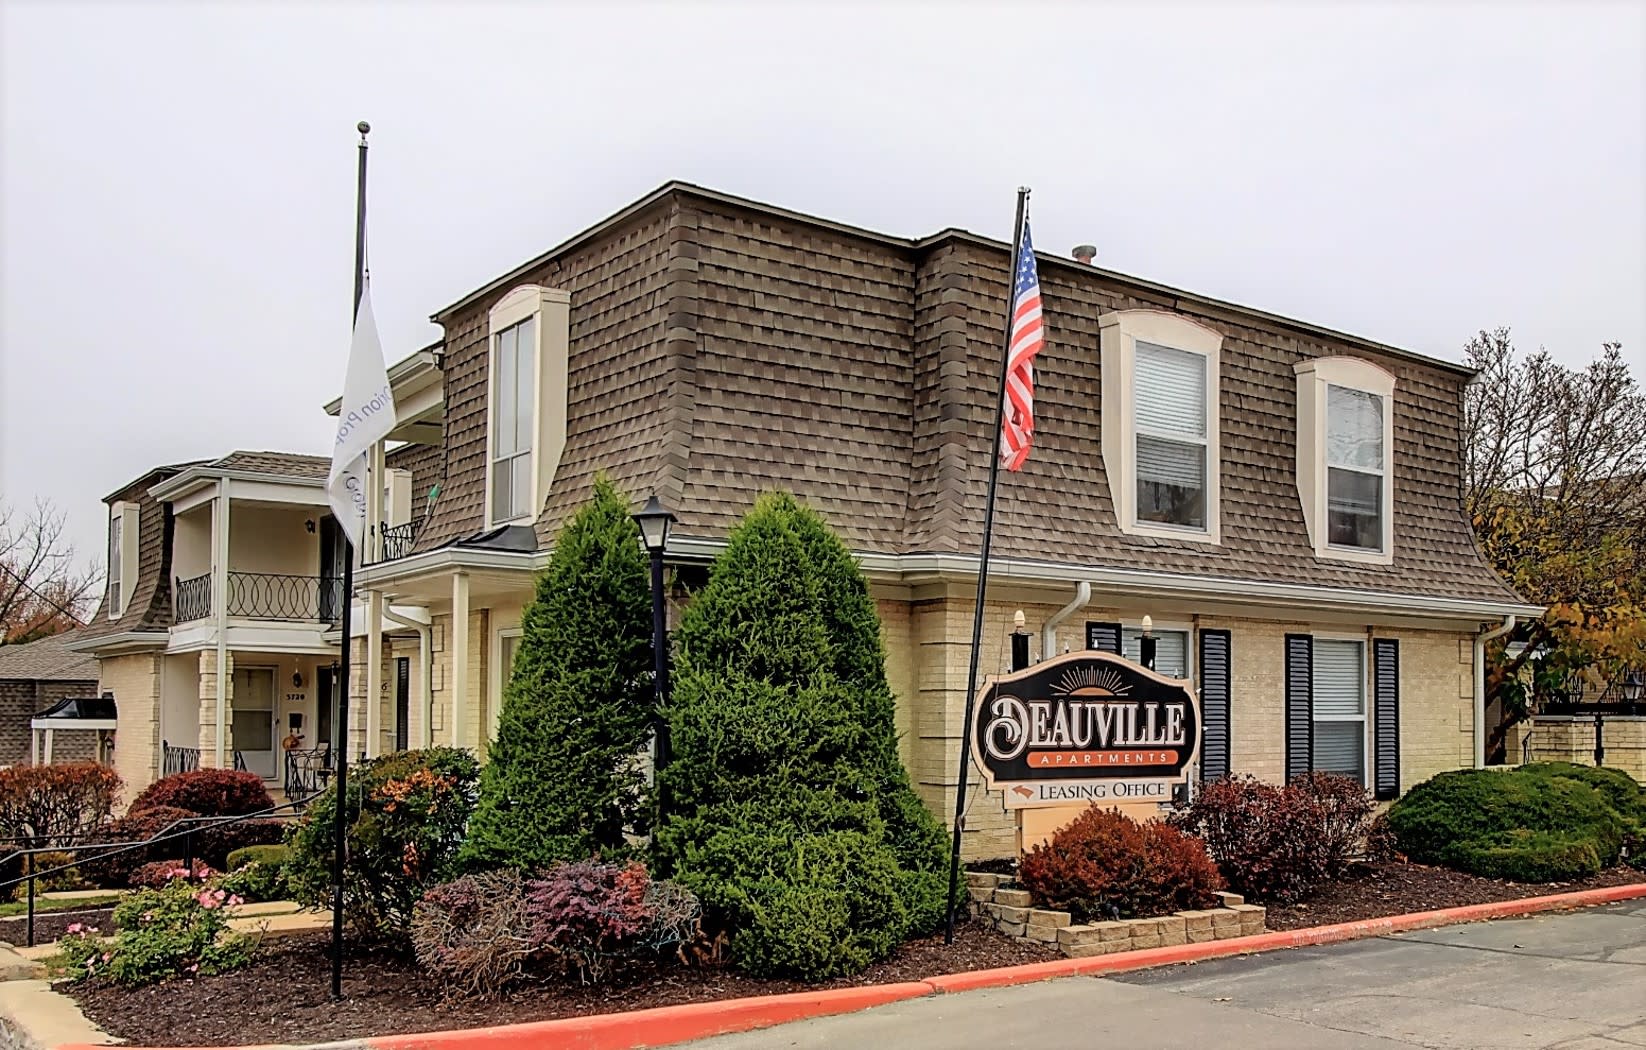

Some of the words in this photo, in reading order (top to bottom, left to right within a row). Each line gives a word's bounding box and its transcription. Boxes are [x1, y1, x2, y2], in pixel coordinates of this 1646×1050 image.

[985, 695, 1186, 760] DEAUVILLE
[1040, 753, 1167, 764] APARTMENTS
[1039, 785, 1106, 800] LEASING
[1112, 782, 1165, 797] OFFICE
